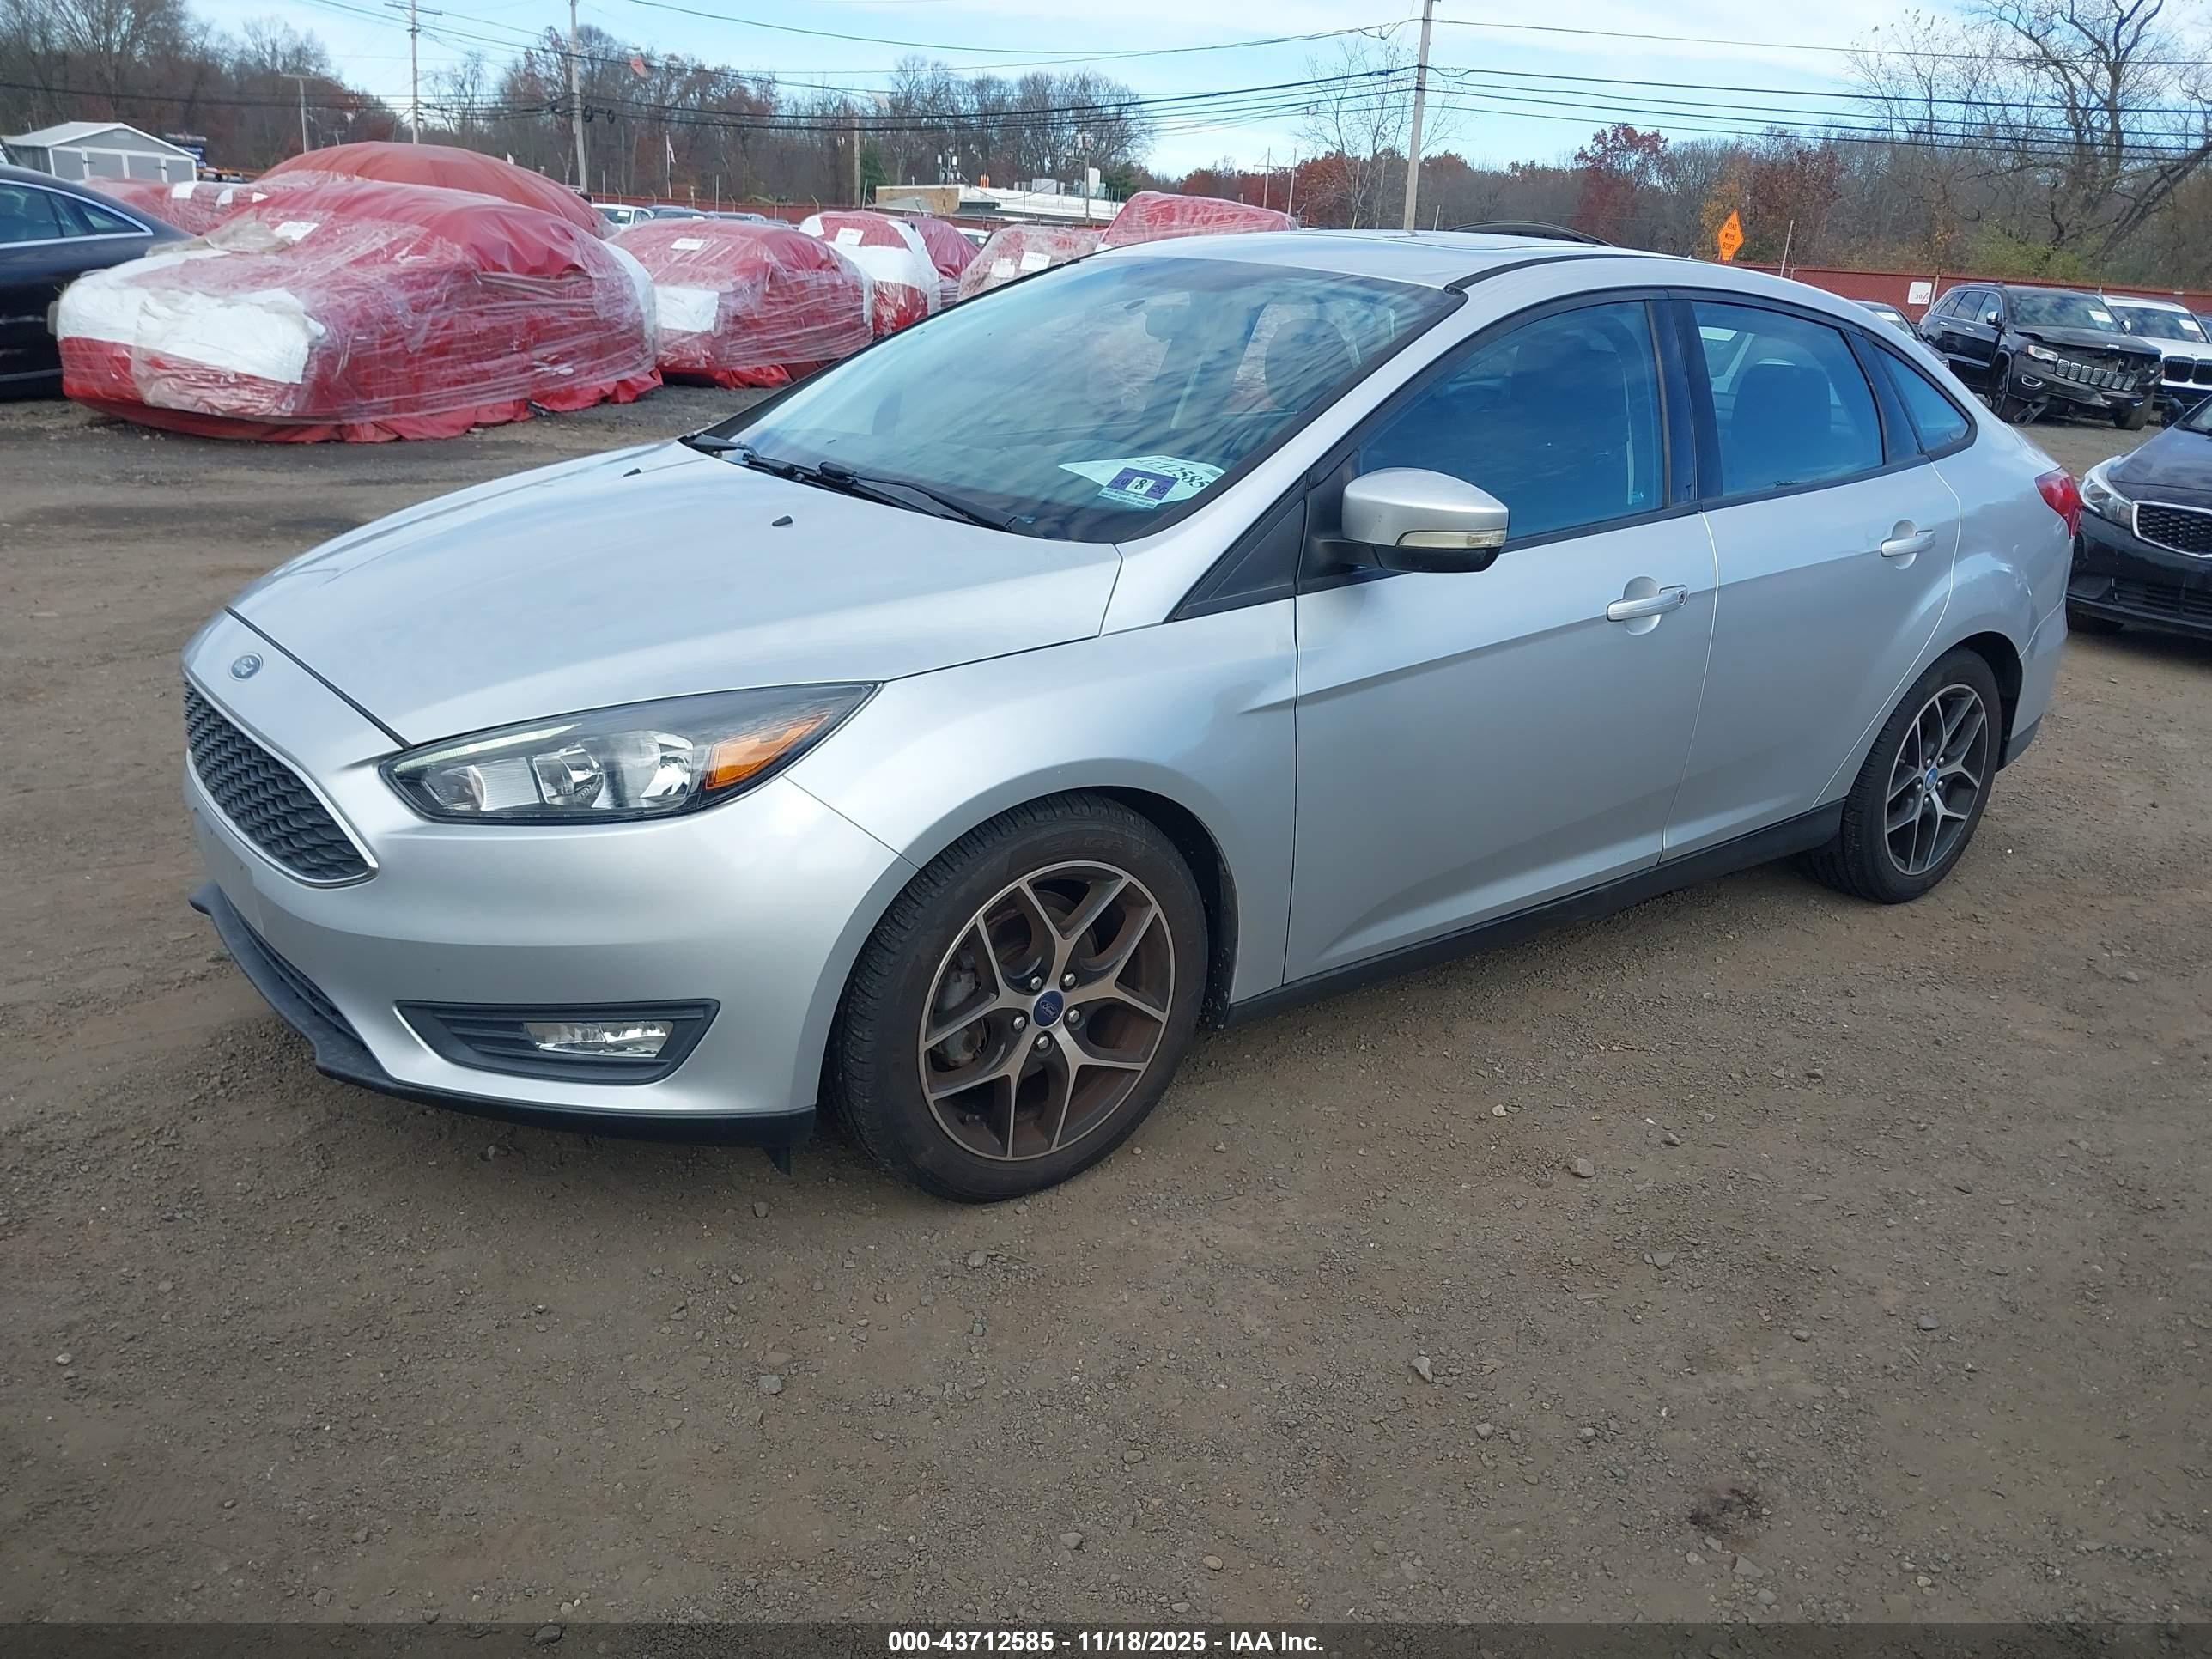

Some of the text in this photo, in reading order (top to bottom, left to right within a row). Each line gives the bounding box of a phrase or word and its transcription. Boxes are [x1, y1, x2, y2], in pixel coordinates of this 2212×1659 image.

[1114, 476, 1168, 495] 20 8 26
